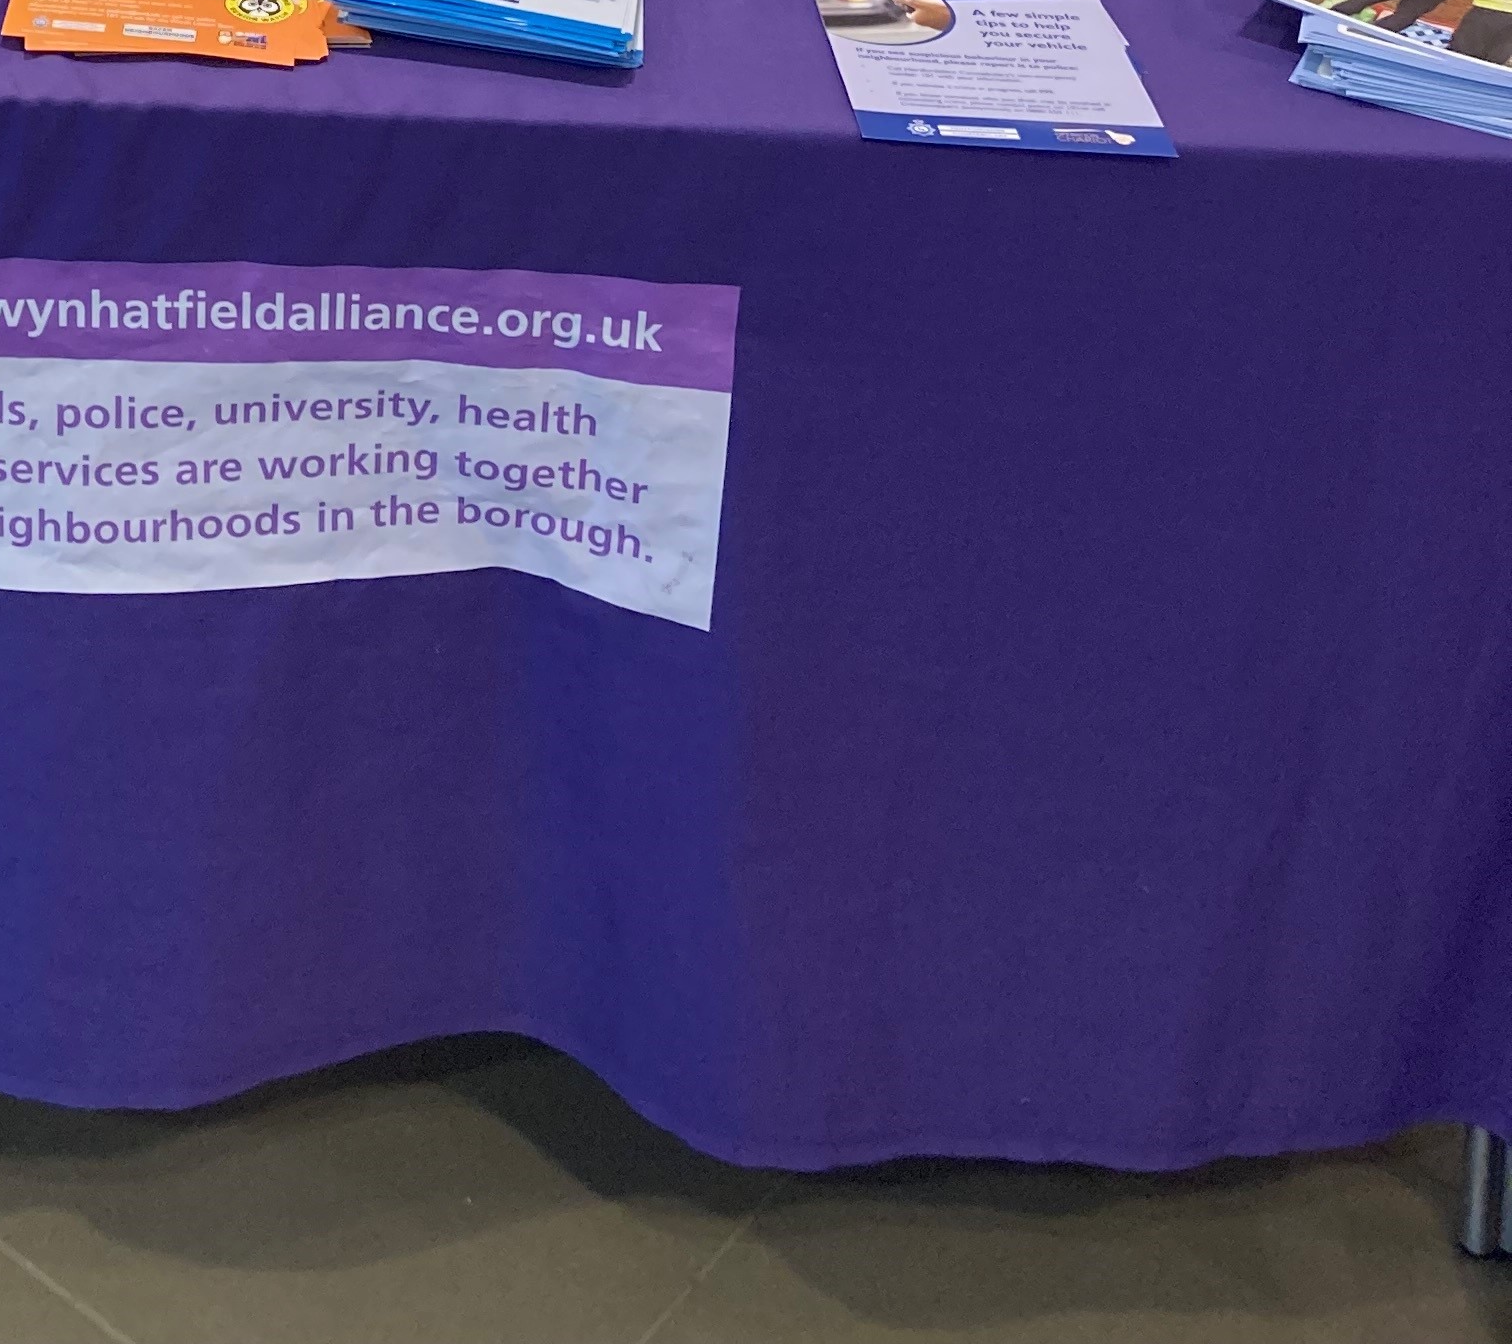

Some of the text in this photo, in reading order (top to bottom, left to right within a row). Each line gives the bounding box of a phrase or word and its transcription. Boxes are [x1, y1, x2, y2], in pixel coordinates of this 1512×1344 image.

[989, 10, 1018, 19] few
[1024, 12, 1080, 22] simple
[975, 19, 1071, 32] tips to help
[979, 30, 1071, 41] you secure
[983, 39, 1088, 51] your vehicle
[56, 395, 196, 436] police,
[215, 390, 440, 426] university,
[458, 394, 598, 436] health
[175, 458, 243, 485] are
[258, 444, 439, 481] working
[454, 450, 649, 505] together
[318, 502, 355, 533] in
[370, 496, 440, 528] the
[457, 496, 654, 563] borough.
